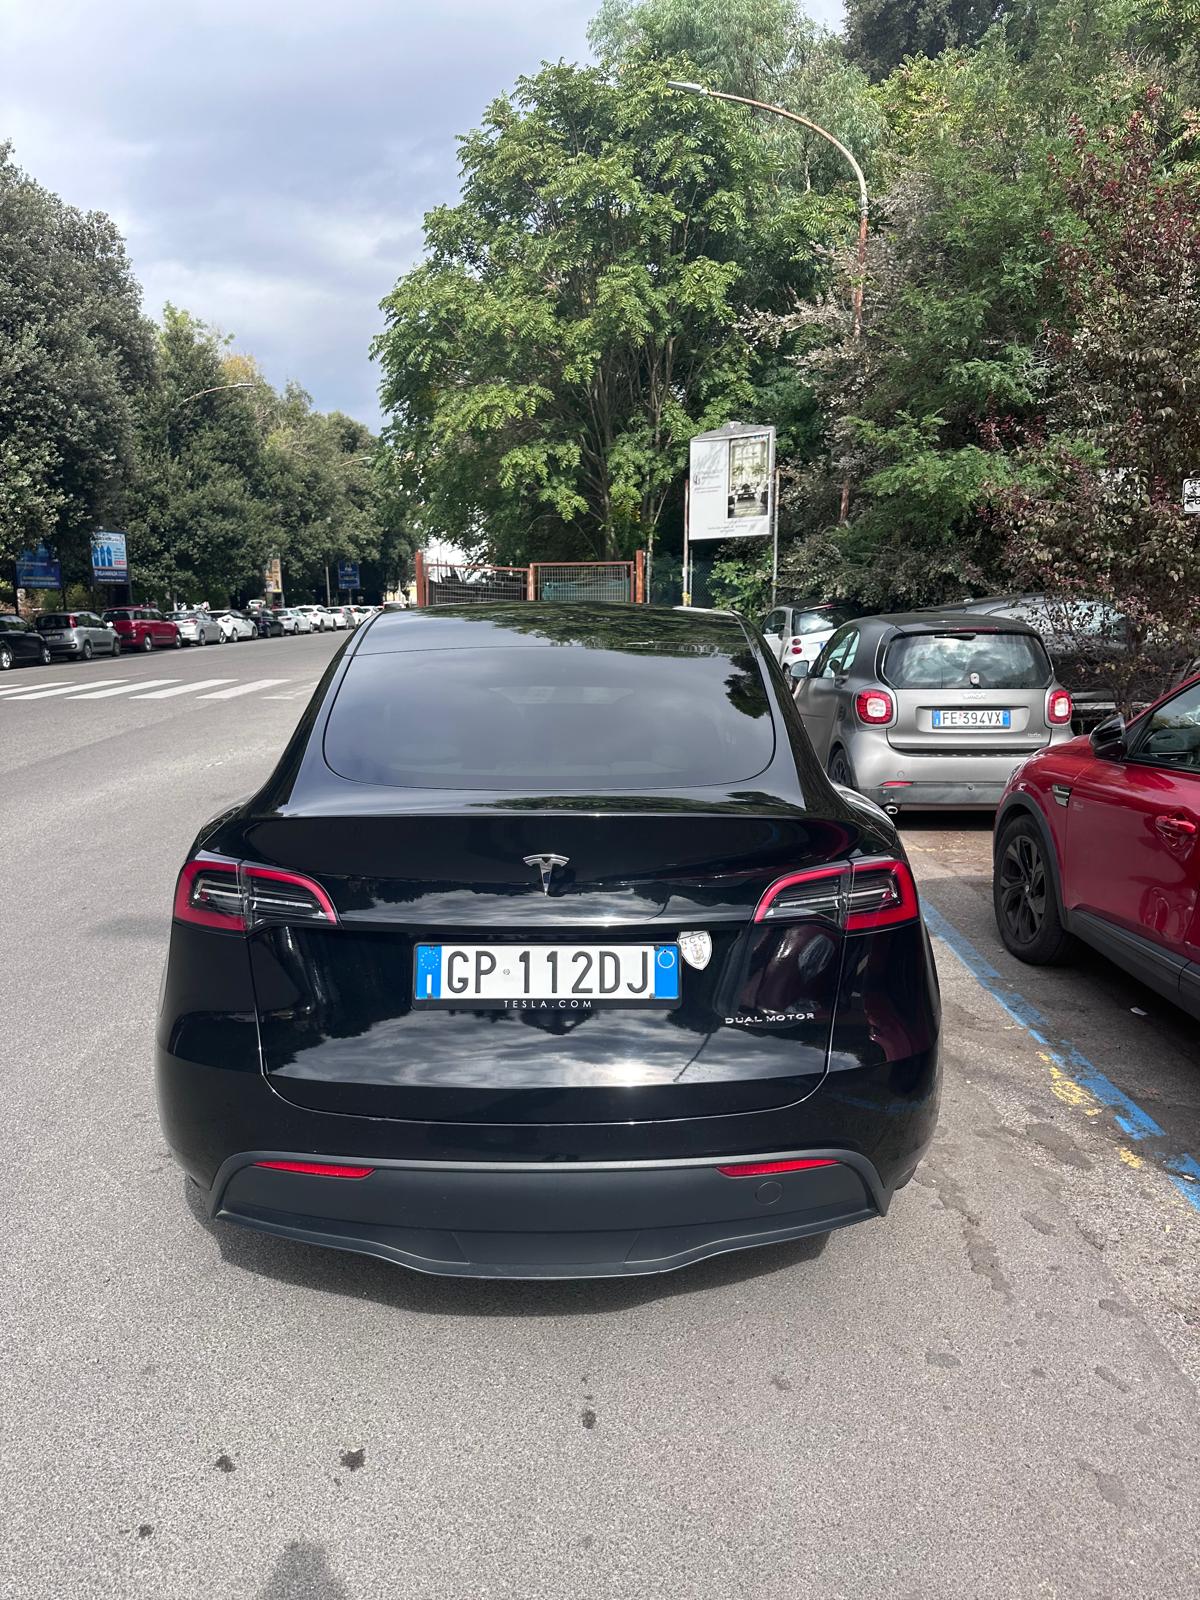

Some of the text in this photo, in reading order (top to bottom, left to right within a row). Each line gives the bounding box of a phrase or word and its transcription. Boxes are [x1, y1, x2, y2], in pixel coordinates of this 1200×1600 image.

[503, 1000, 593, 1009] TESLA.COM
[724, 1012, 815, 1024] DUAL MOTOR
